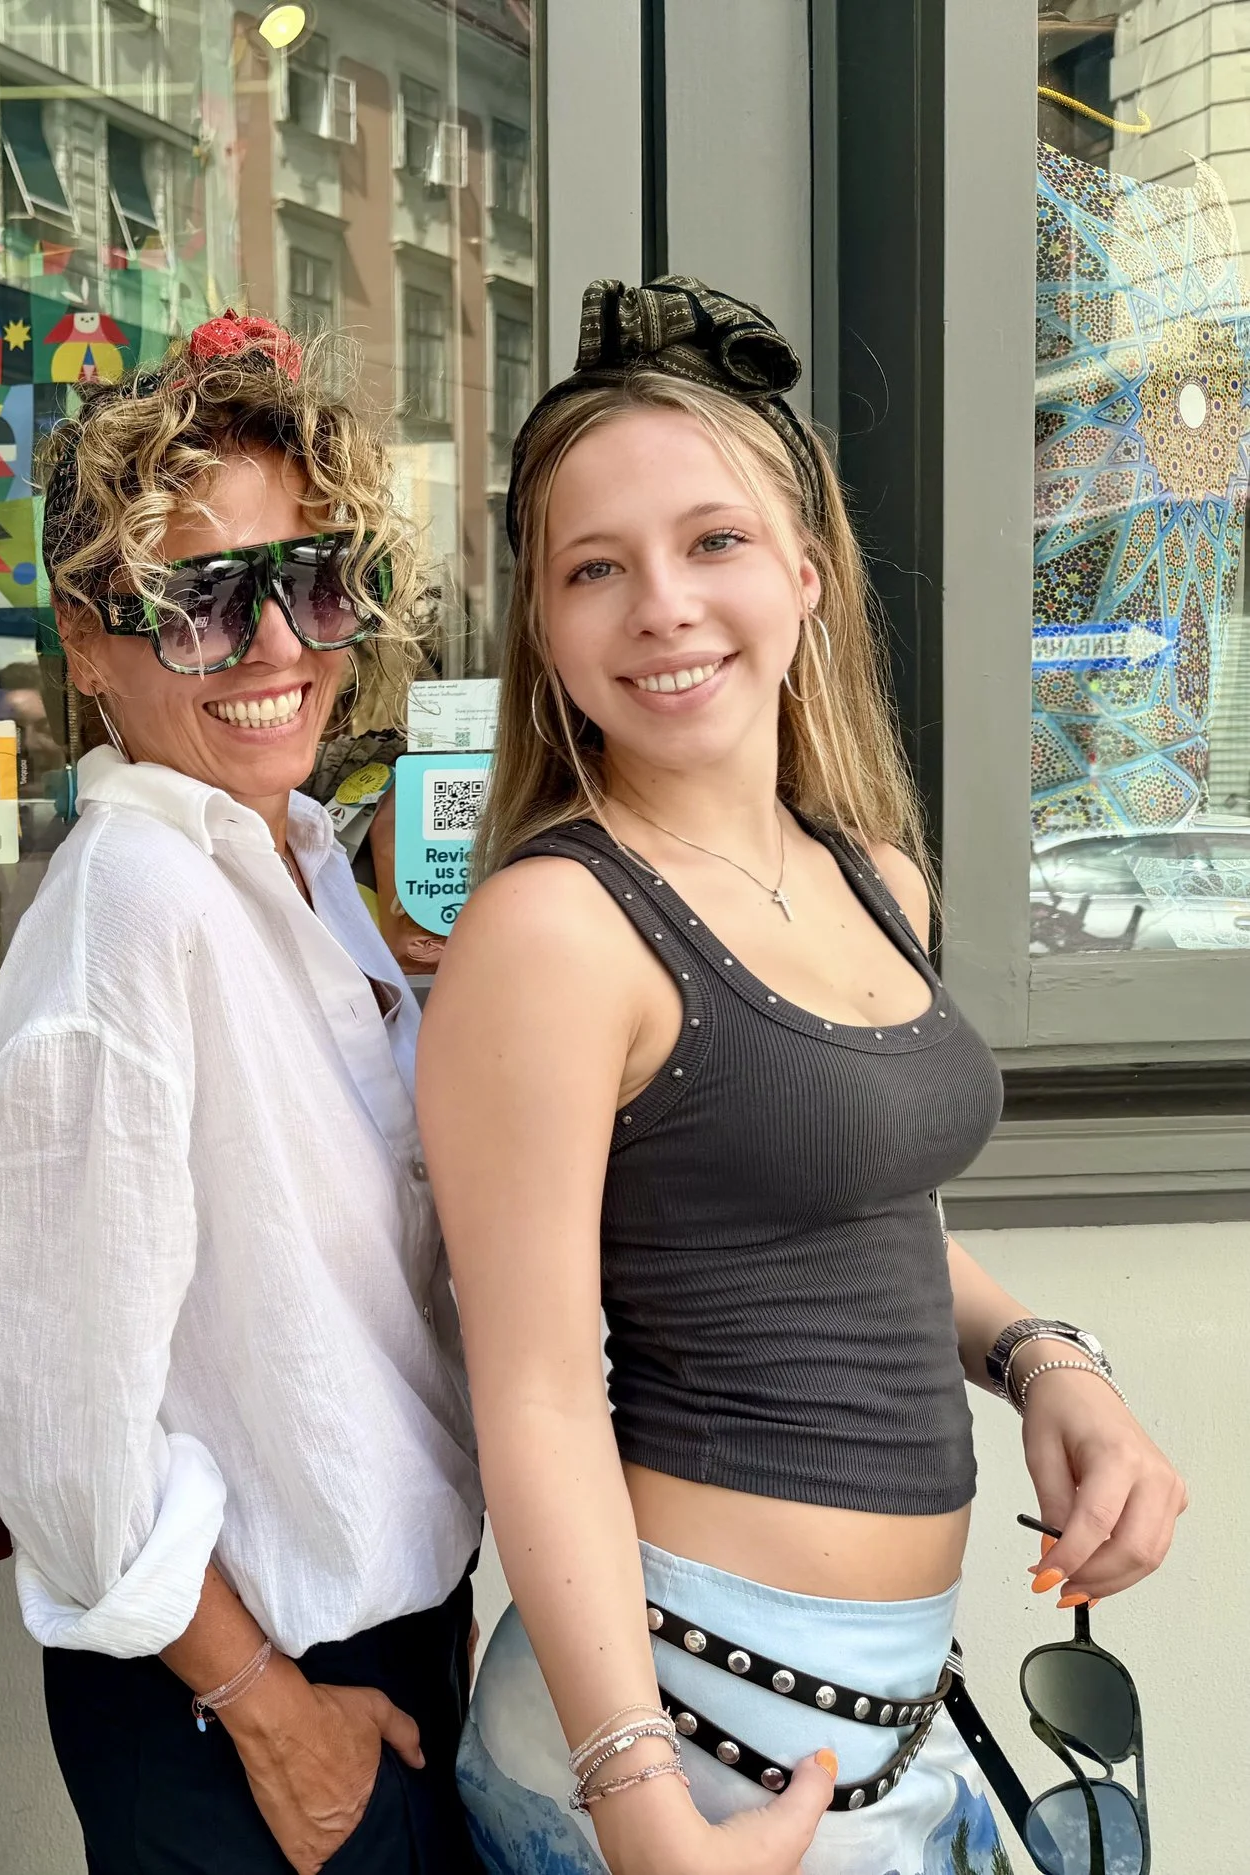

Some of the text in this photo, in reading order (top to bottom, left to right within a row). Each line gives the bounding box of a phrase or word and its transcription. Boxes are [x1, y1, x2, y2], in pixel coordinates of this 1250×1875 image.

[359, 773, 376, 784] UV
[426, 847, 474, 863] Revie
[435, 867, 455, 879] us
[406, 880, 470, 899] Tripad
